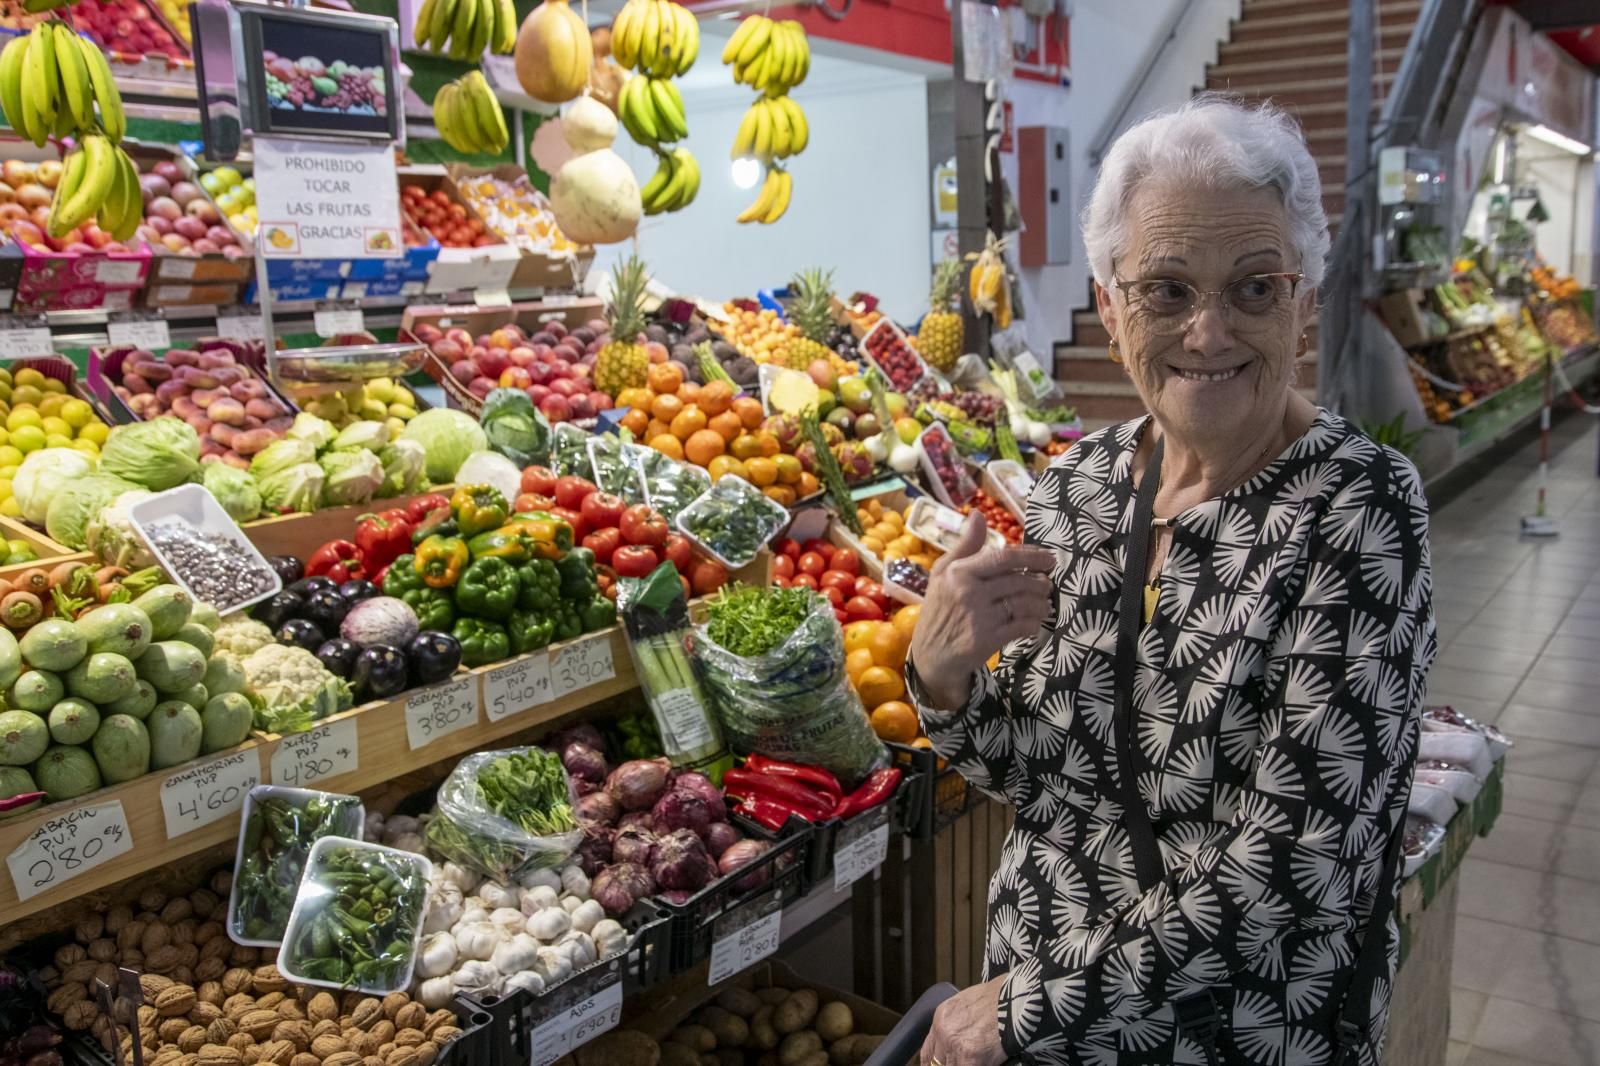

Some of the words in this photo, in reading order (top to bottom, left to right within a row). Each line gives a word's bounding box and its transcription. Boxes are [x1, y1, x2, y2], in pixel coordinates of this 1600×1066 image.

[285, 156, 366, 174] PROHIBIDO
[304, 179, 351, 193] TOCAR
[286, 202, 313, 216] LAS
[318, 203, 371, 217] FRUTAS
[300, 225, 362, 239] GRACIAS
[560, 660, 604, 689] 3'90
[493, 686, 535, 714] 5'40
[417, 708, 461, 736] 3'80
[801, 711, 846, 740] FRUTAS
[283, 757, 334, 786] 4'80
[177, 785, 240, 821] 4'60
[28, 836, 104, 888] 2'80
[576, 1015, 606, 1039] 6'90
[610, 1006, 620, 1024] €
